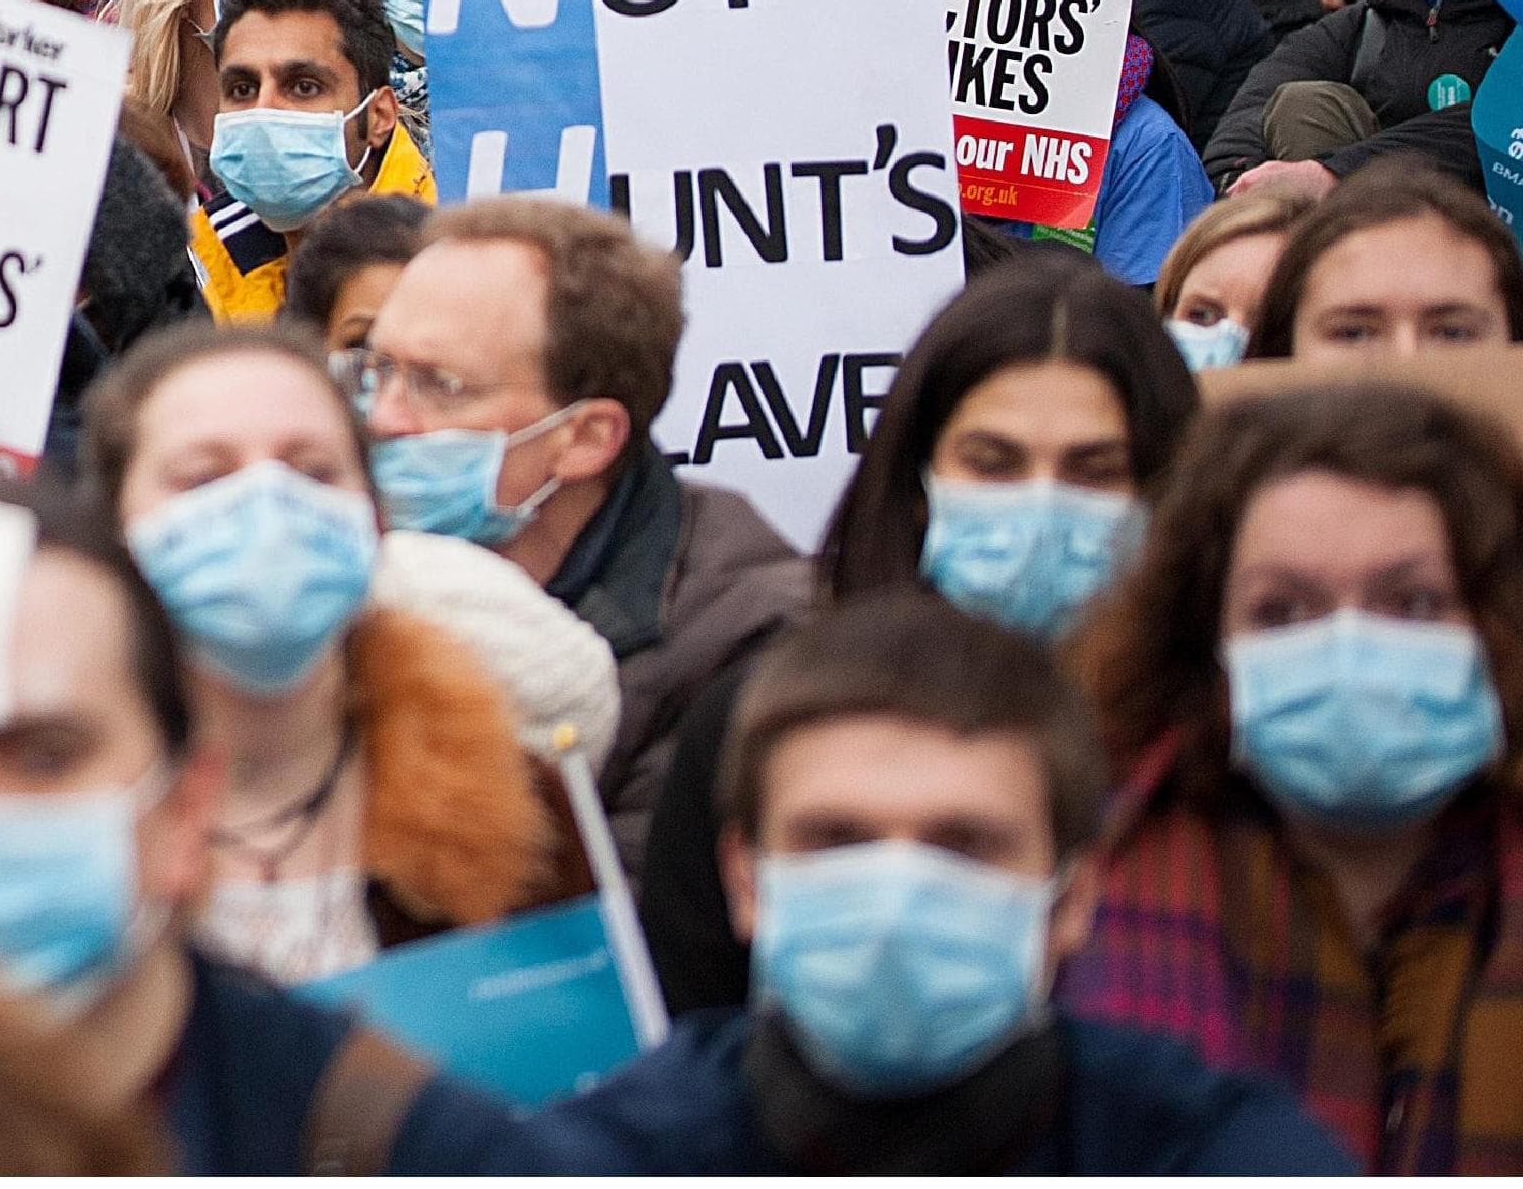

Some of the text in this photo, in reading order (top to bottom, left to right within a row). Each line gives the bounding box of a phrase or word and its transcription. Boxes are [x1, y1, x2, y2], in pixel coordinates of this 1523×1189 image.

[957, 132, 1093, 186] our NHS
[957, 182, 1019, 207] .org.uk
